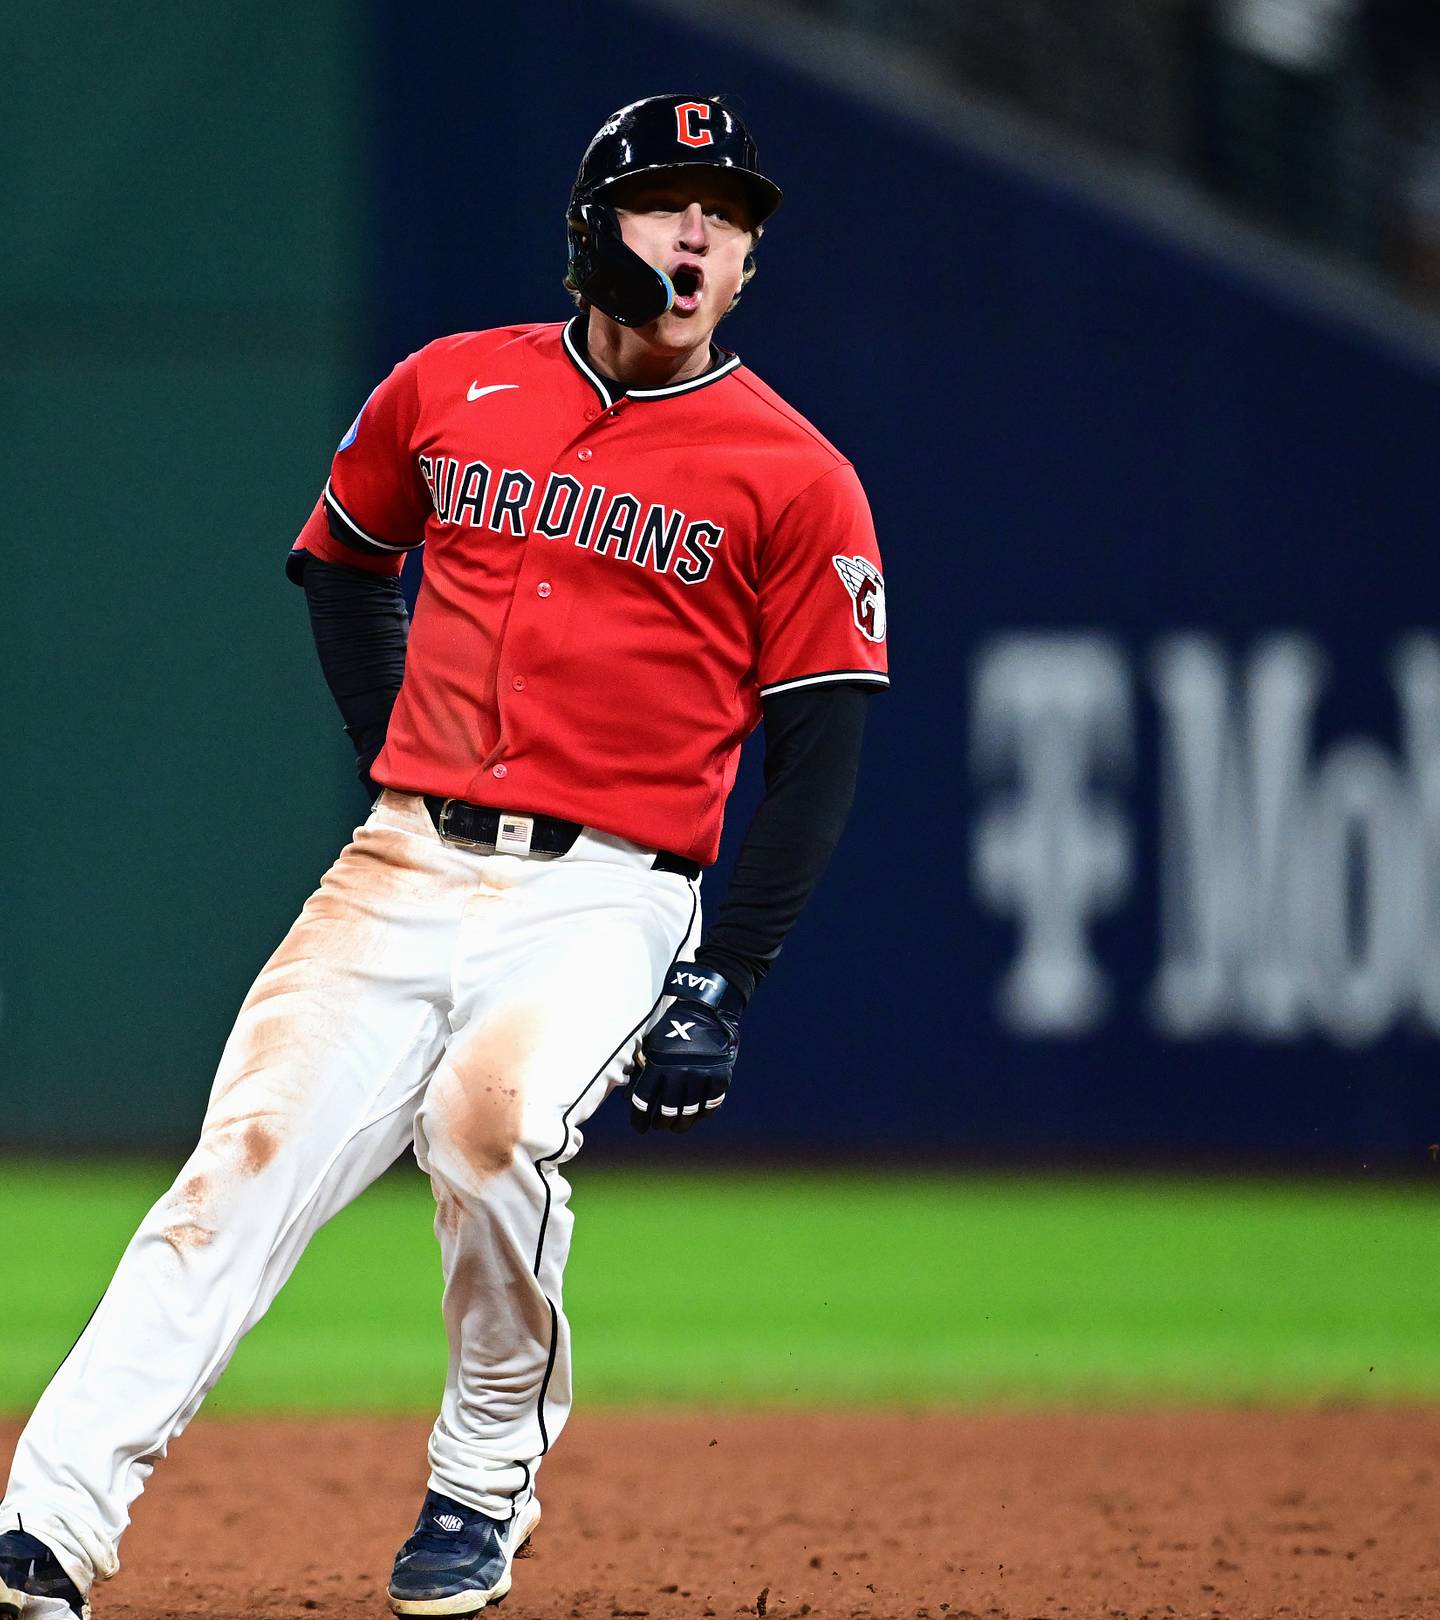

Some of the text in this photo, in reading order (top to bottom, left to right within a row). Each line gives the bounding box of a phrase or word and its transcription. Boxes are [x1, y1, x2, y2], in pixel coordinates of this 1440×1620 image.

[675, 102, 713, 148] C
[1150, 630, 1440, 1045] Mo
[670, 971, 718, 992] JAX
